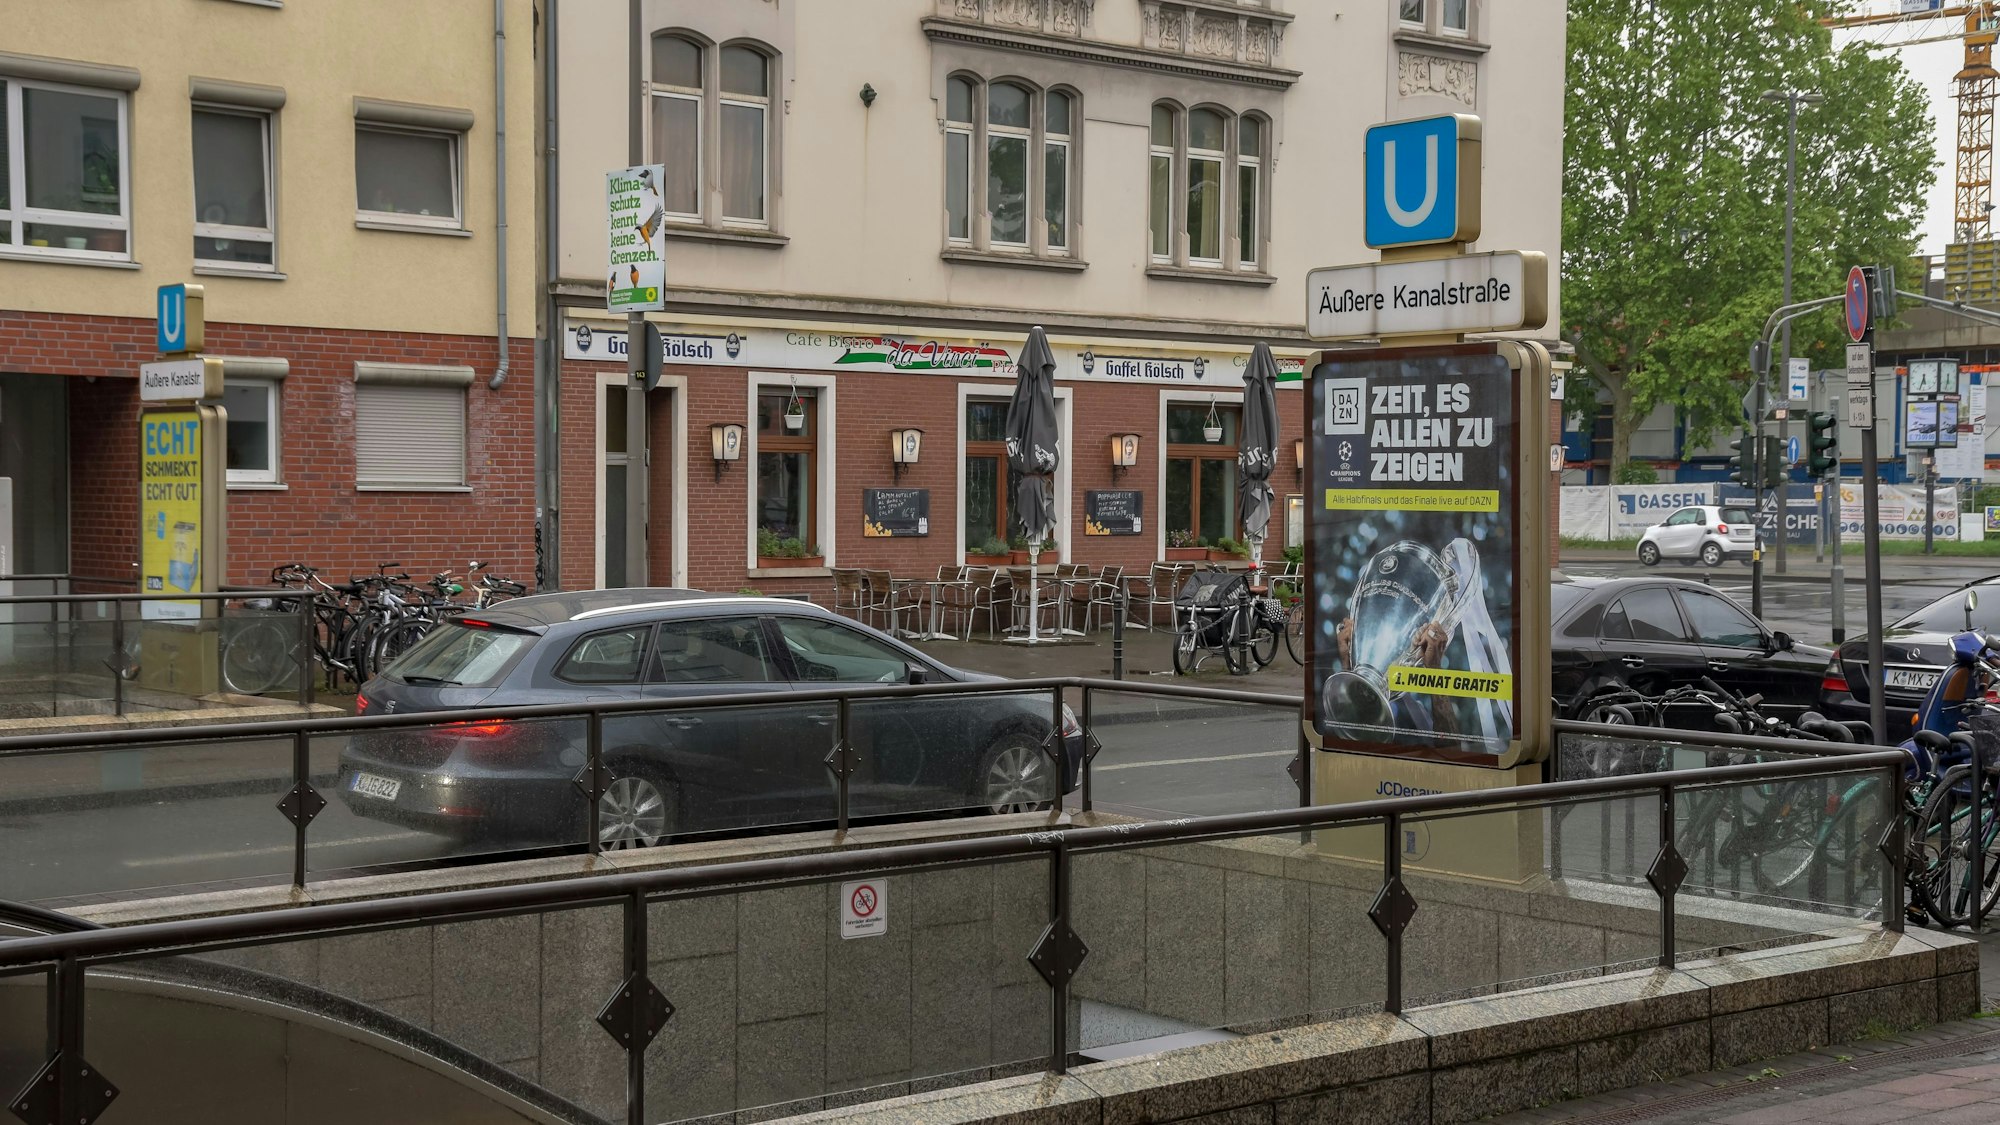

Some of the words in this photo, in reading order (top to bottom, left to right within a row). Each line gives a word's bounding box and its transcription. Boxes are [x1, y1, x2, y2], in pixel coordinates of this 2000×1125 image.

[1384, 134, 1438, 227] U
[610, 195, 641, 212] schutz
[610, 212, 638, 230] kennt
[610, 231, 636, 248] keine
[610, 249, 660, 265] Grenzen.
[1319, 287, 1384, 314] Äußere
[1393, 277, 1511, 309] Kanalstraße
[163, 293, 180, 343] U
[786, 332, 822, 347] Cafe
[828, 334, 874, 350] Bistro
[1106, 360, 1142, 378] Gaffel
[1144, 362, 1184, 380] Kölsch
[144, 371, 169, 388] Äußere
[1338, 393, 1352, 405] DA
[1371, 384, 1430, 418] ZEIT,
[1436, 382, 1470, 413] ES
[1339, 407, 1352, 419] ZN
[145, 421, 198, 455] ECHT
[1370, 418, 1451, 448] ALLEN
[1457, 417, 1493, 447] ZU
[145, 461, 197, 477] SCHMECKT
[1370, 452, 1463, 482] ZEIGEN
[146, 483, 172, 500] ECHT
[175, 483, 197, 500] GUT
[1332, 495, 1345, 504] Alle
[1346, 495, 1382, 505] Halbfinals
[1383, 496, 1399, 505] und
[1400, 496, 1414, 505] das
[1414, 496, 1437, 505] Finale
[1438, 496, 1453, 505] live
[1454, 496, 1469, 506] auf
[1469, 496, 1492, 506] DAZN
[1638, 492, 1705, 509] GASSEN
[1407, 674, 1451, 690] MONAT
[1892, 672, 1901, 687] K
[1908, 674, 1924, 686] MX
